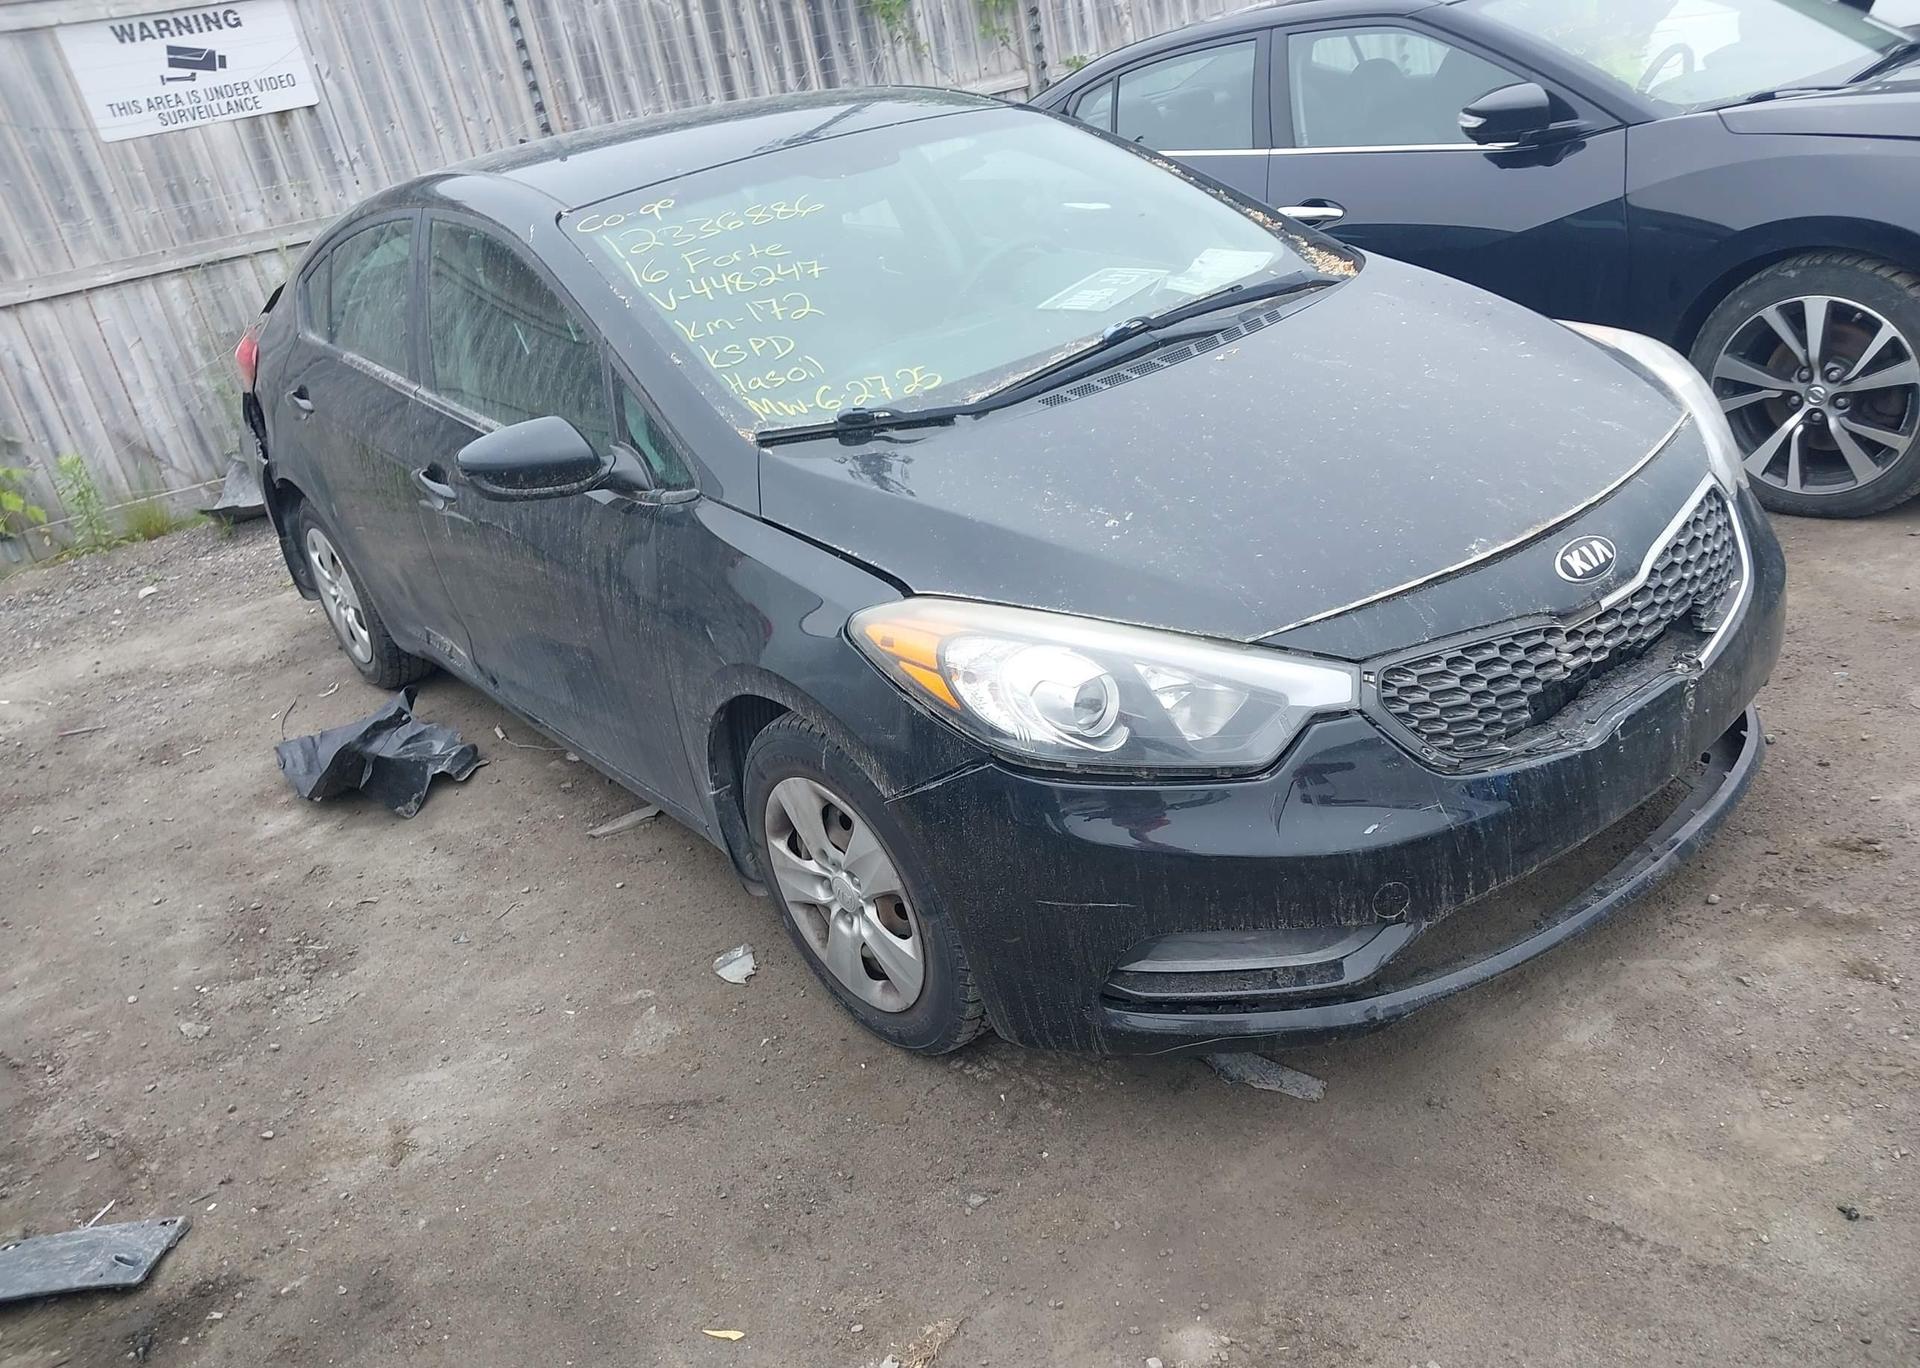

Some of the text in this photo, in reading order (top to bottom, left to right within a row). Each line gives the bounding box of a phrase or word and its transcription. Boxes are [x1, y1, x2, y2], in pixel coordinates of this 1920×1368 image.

[110, 9, 242, 44] WARNING
[106, 73, 296, 119] THIS AREA IS UNDER VIDEO
[157, 96, 263, 127] SURVEILLANCE
[602, 194, 825, 259] 12336886
[626, 243, 792, 288] 16 Forte
[1562, 540, 1614, 577] KIA
